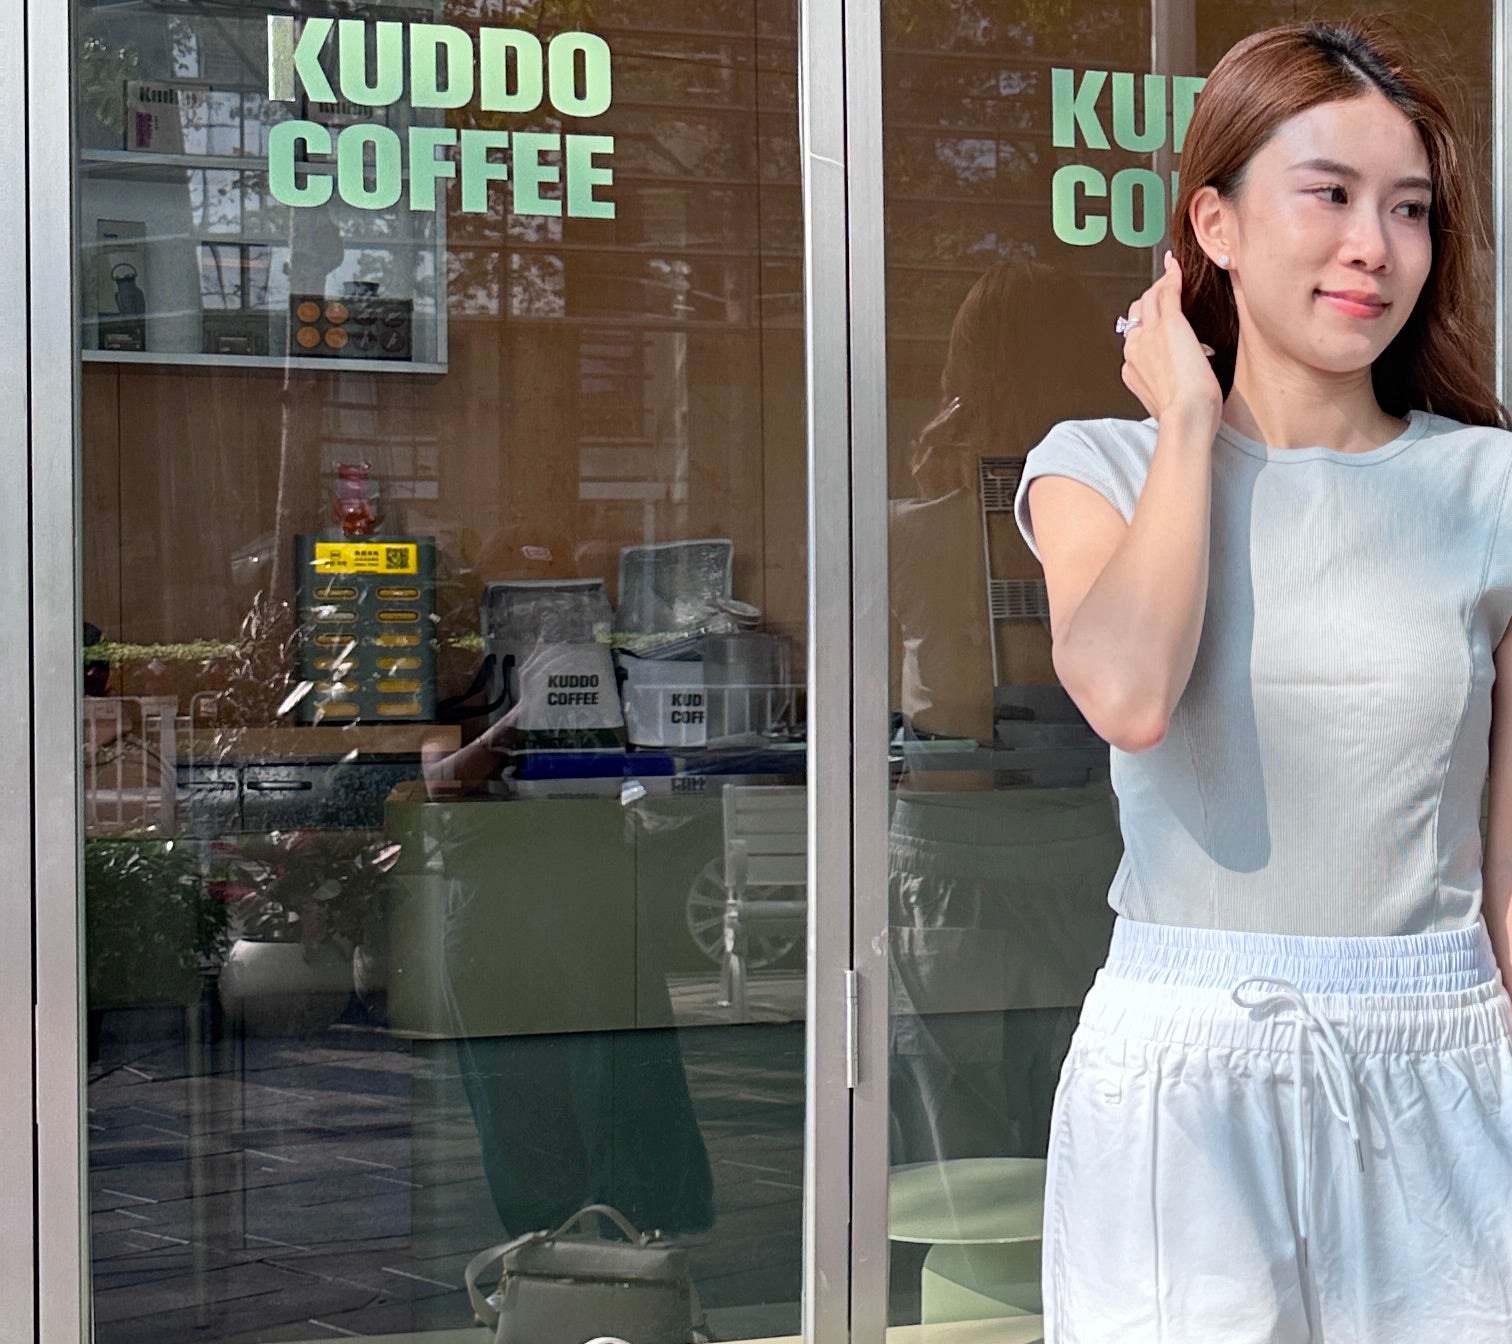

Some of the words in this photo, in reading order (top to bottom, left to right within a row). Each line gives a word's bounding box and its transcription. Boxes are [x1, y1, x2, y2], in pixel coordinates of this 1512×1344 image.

[267, 14, 613, 118] KUDDO
[267, 117, 616, 220] COFFEE
[547, 692, 599, 706] COFFEE
[548, 674, 599, 688] KUDDO
